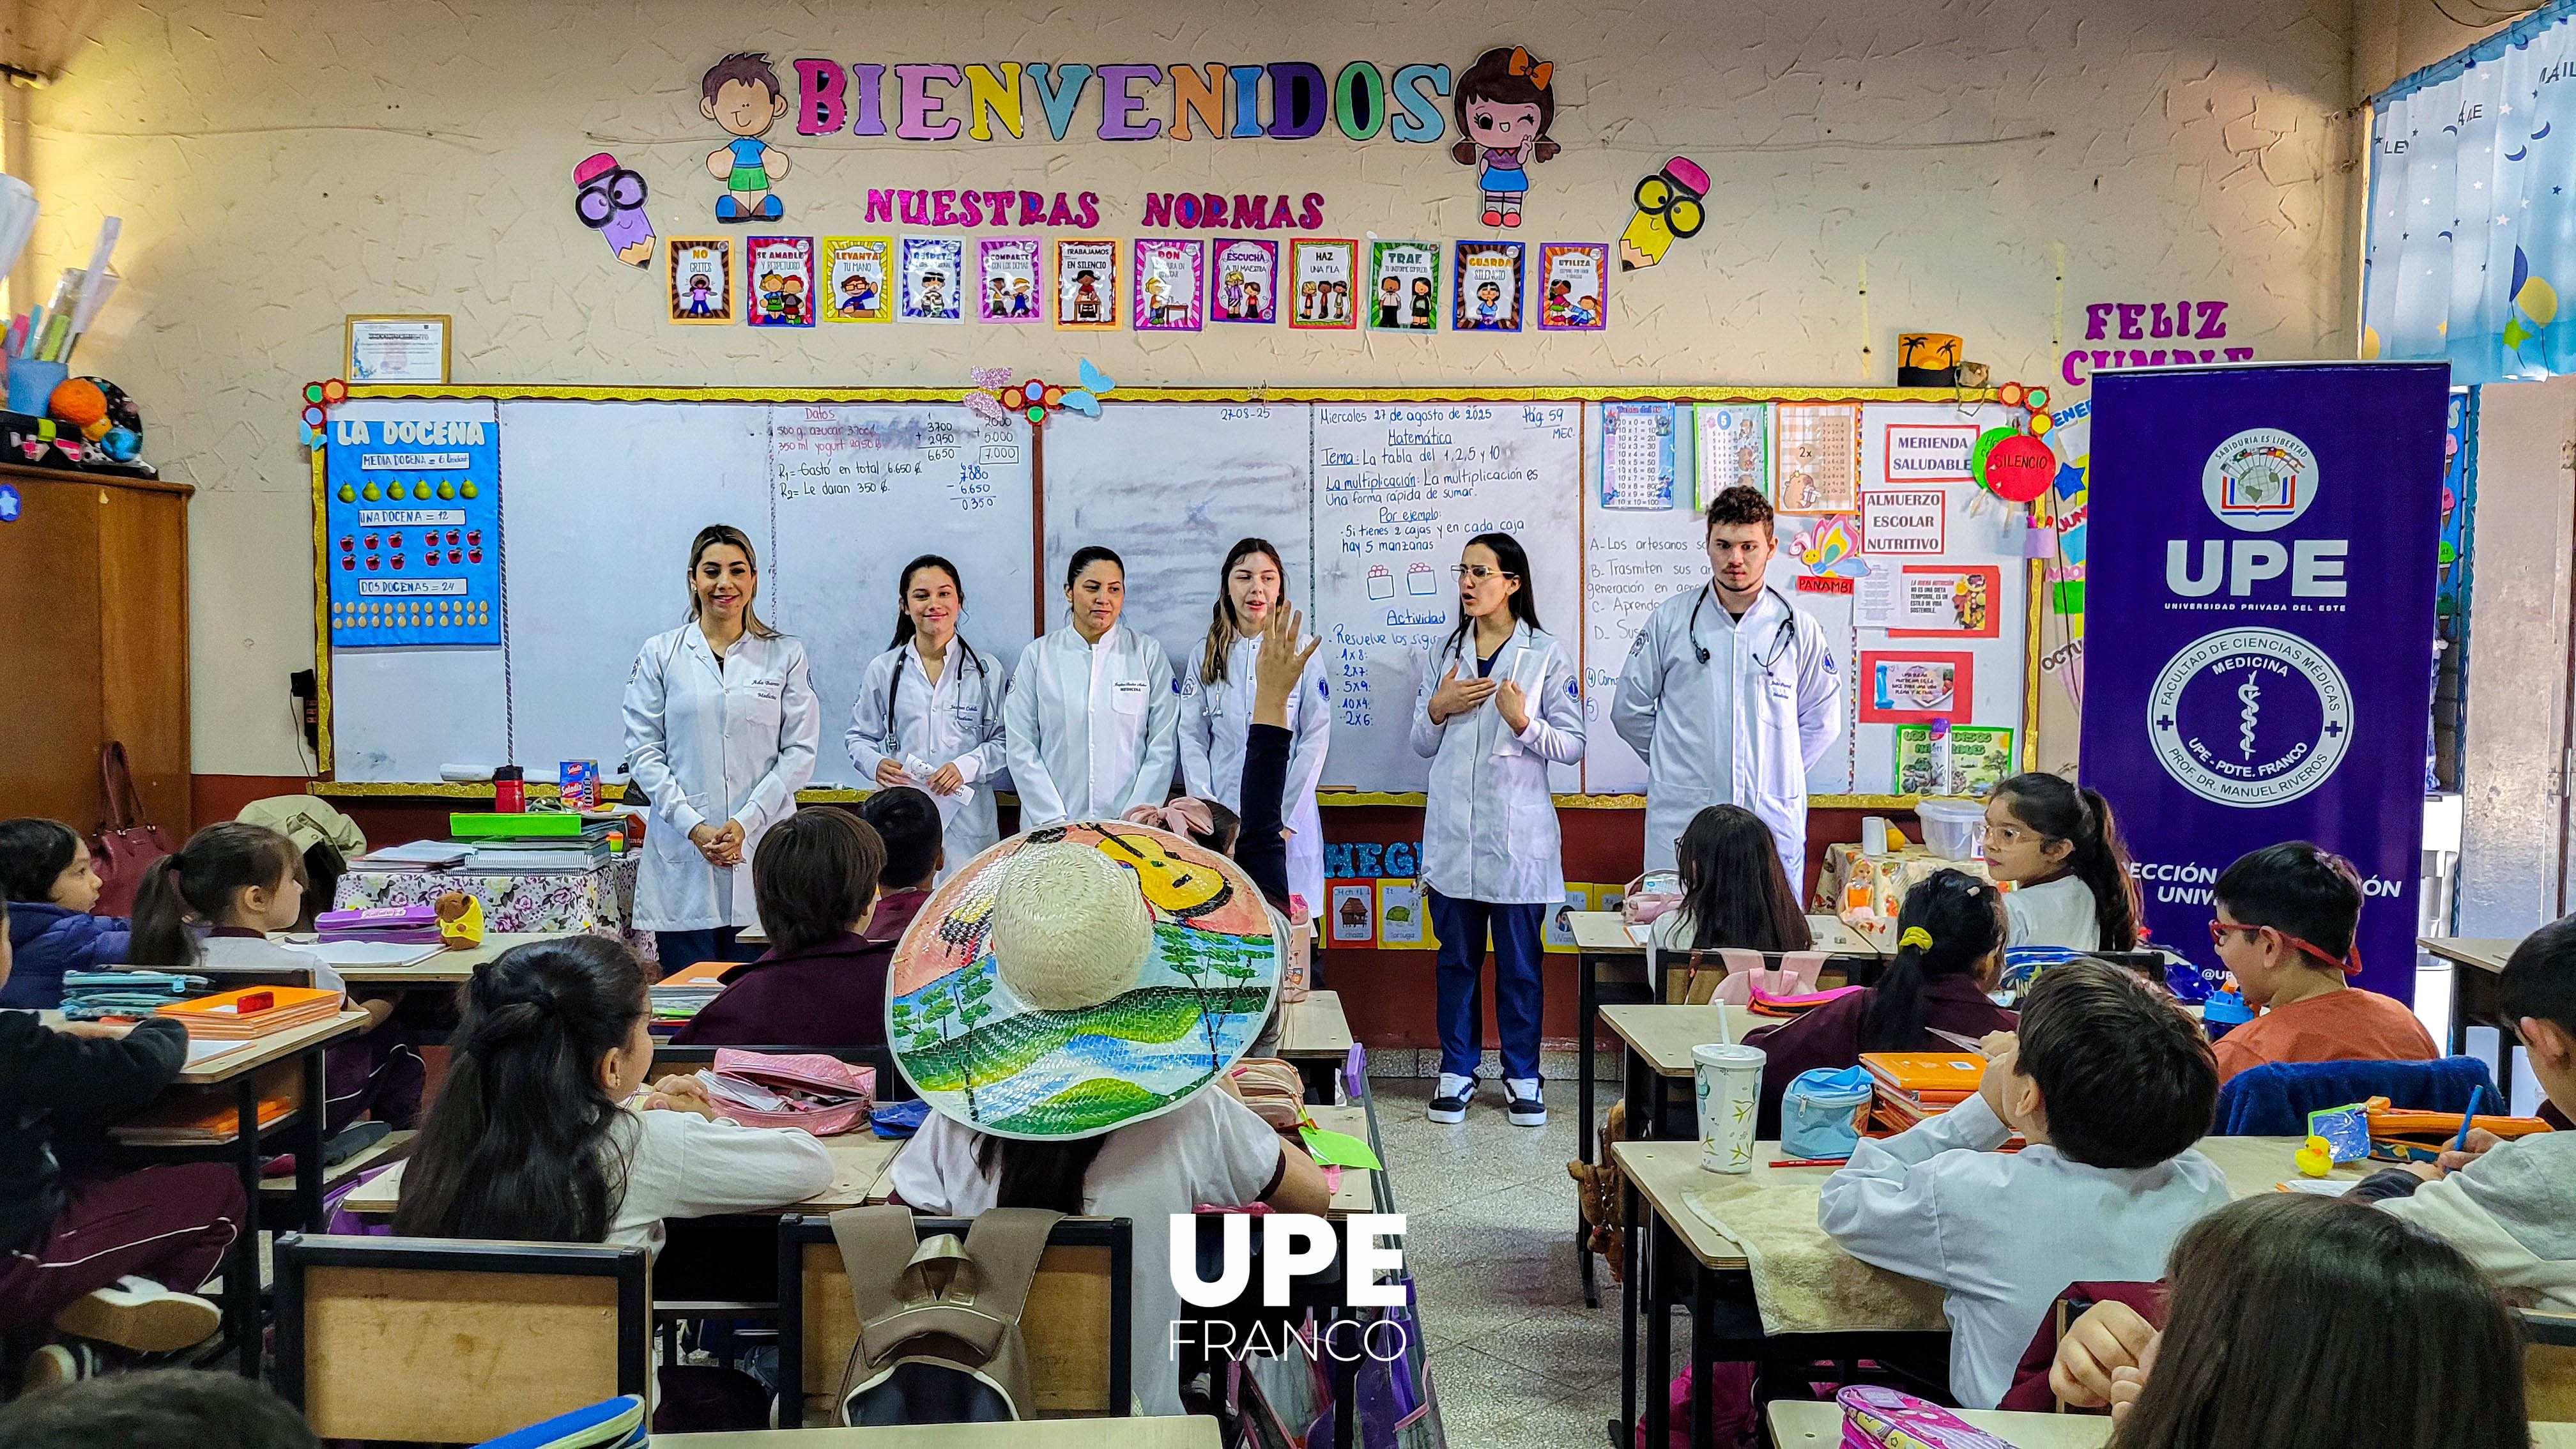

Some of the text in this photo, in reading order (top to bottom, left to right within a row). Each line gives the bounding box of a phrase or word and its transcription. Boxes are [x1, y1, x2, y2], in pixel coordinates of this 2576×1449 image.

[793, 57, 1450, 143] BIENVENIDOS
[864, 188, 1324, 230] NUESTRAS NORMAS
[693, 250, 708, 259] NO
[836, 252, 879, 261] LEVANTA
[1227, 252, 1265, 262] ESCUCHA
[1315, 252, 1333, 261] HAZ
[689, 262, 712, 272] GRITES
[761, 261, 800, 270] Y RESPETUOSO
[843, 263, 871, 272] TU MANO
[1232, 264, 1239, 273] TU
[1240, 264, 1267, 273] MAESTRA
[1469, 257, 1512, 267] GUARDA
[1558, 259, 1590, 267] UTILIZA
[1310, 265, 1340, 273] UNA FILA
[1475, 269, 1506, 280] SILENCIO
[2085, 300, 2228, 339] FELIZ
[805, 407, 836, 420] Datos
[1221, 408, 1271, 420] 27-08-25
[1321, 407, 1492, 427] Miercoles 27 de agosto de 2025
[1549, 408, 1564, 422] 59
[1721, 415, 1728, 425] 5
[337, 420, 485, 445] LA DOCENA
[809, 426, 843, 436] azucar
[985, 431, 1013, 443] 5.000
[1388, 426, 1452, 445] Matemática
[778, 440, 846, 457] 350 ml yogurt
[1898, 437, 1968, 449] MERIENDA
[2215, 435, 2308, 460] SABIDURIA ES LIBERTAD
[928, 448, 954, 461] 6.650
[985, 447, 1016, 460] 7.000
[1321, 447, 1360, 466] Tema:
[1363, 448, 1376, 466] La
[1381, 448, 1413, 463] tabla
[1420, 447, 1435, 462] del
[1480, 450, 1485, 463] y
[1489, 445, 1500, 460] 10
[1799, 447, 1812, 457] 2x
[364, 454, 445, 466] MEDIA DOCENA 6
[1893, 458, 1972, 471] SALUDABLE
[1993, 454, 2048, 470] SILENCIO
[798, 458, 831, 476] Gastó
[856, 461, 879, 475] total
[887, 463, 912, 473] 6.650
[1326, 466, 1538, 493] La multiplicación: La multiplicación es
[804, 482, 877, 495] Le daran 350
[960, 484, 991, 494] 6.650
[1325, 487, 1477, 507] Una forma rápida de sumar.
[1867, 494, 1940, 506] ALMUERZO
[360, 510, 449, 523] UNA DOCENA 12
[1379, 506, 1442, 524] Por ejemplo:
[1358, 523, 1389, 537] tienes
[1395, 526, 1402, 535] 2
[1404, 525, 1432, 539] cajas
[1436, 525, 1444, 539] y
[1446, 523, 1459, 533] en
[1464, 518, 1493, 532] cada
[1499, 519, 1525, 534] caja
[1873, 516, 1934, 528] ESCOLAR
[1342, 539, 1434, 558] hay 5 manzanas
[1607, 537, 1688, 551] Los artesanos
[1867, 538, 1939, 550] NUTRITIVO
[1606, 558, 1691, 576] Trasmiten sus
[2165, 539, 2349, 597] UPE
[362, 581, 454, 592] DOS DOCENAS 24
[1587, 580, 1667, 600] generación en
[1799, 578, 1852, 594] PANAMBI
[1386, 608, 1446, 626] Actividad
[1333, 623, 1407, 646] Resuelve los
[2212, 656, 2289, 677] MEDICINA
[2161, 638, 2340, 712] FACULTAD DE CIENCIAS MÉDICAS
[2188, 737, 2308, 778] UPE PDTE. FRANCO
[2168, 747, 2328, 797] PROF. DR. MANUEL RIVEROS
